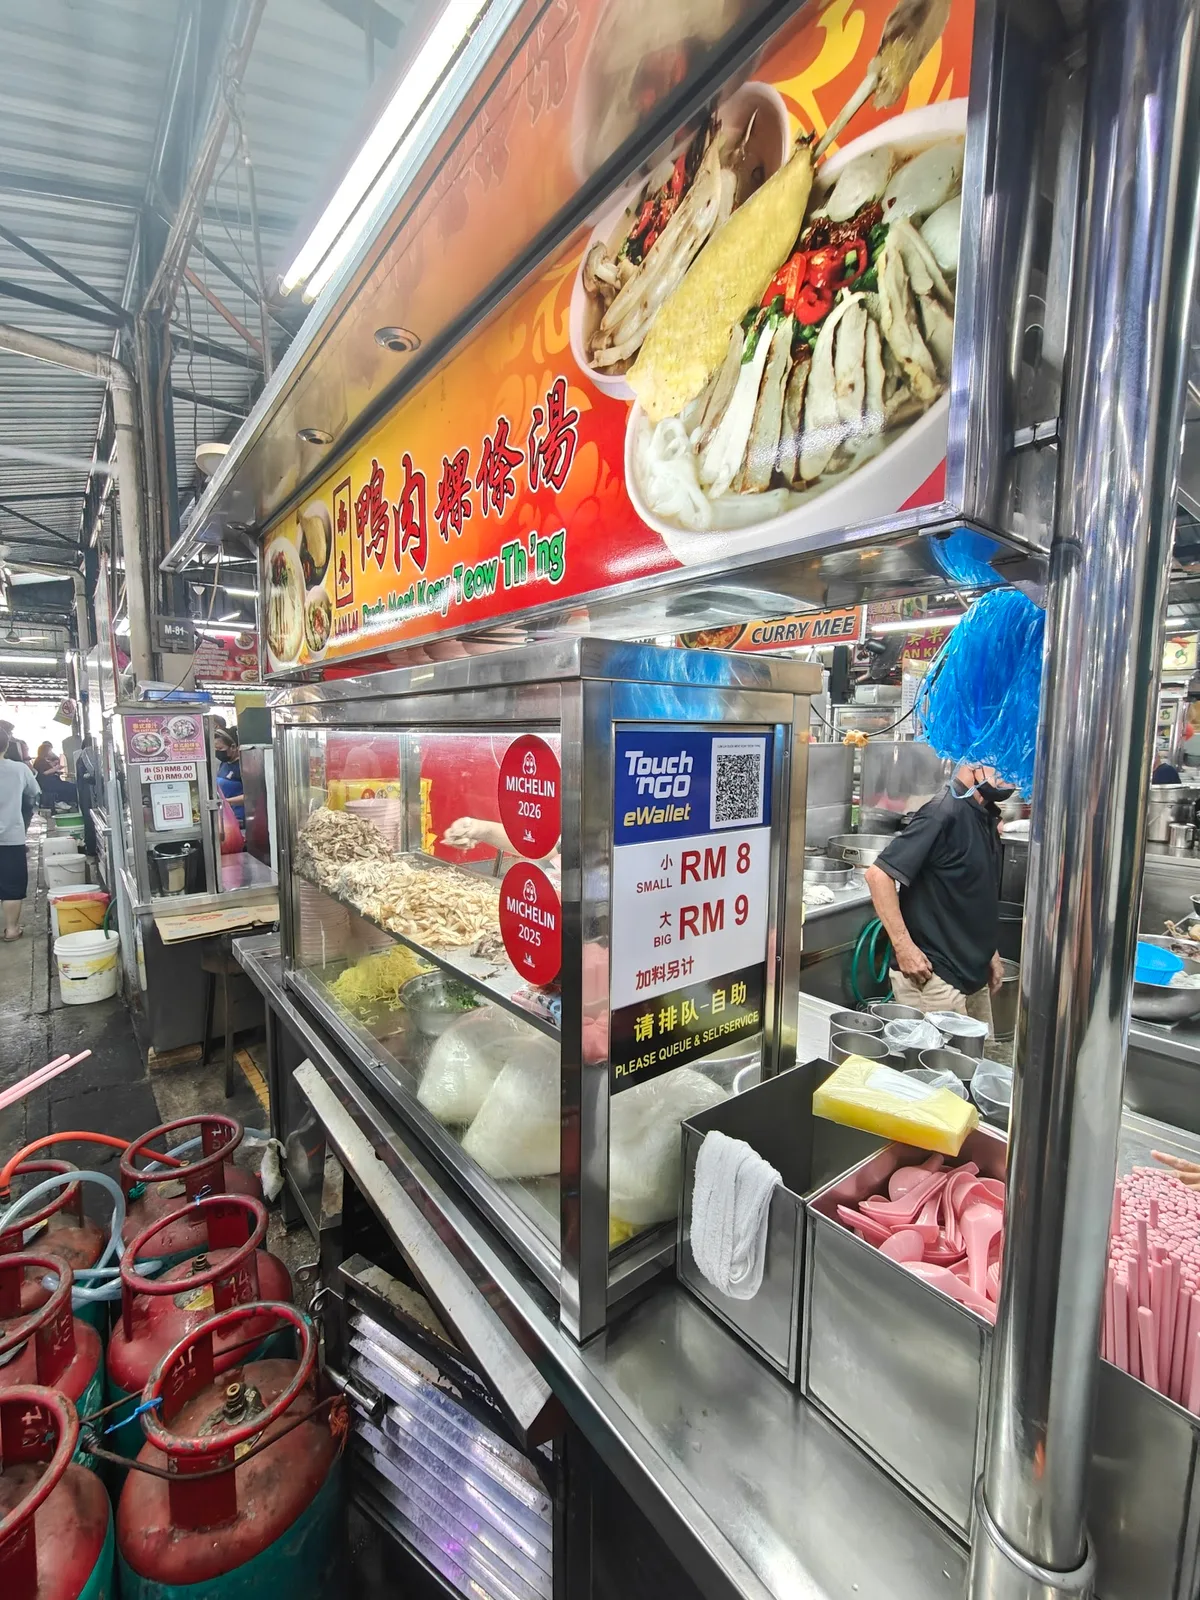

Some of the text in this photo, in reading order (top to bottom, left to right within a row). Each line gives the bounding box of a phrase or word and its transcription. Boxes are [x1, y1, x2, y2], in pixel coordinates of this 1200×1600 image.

[453, 557, 498, 603] Teow
[164, 624, 185, 636] M-81
[751, 615, 856, 645] CURRY MEE
[164, 764, 193, 773] RM8.00
[624, 750, 694, 776] Touch
[153, 774, 165, 782] (B)
[165, 772, 193, 780] RM9.00
[506, 775, 556, 798] MICHELIN
[517, 800, 542, 819] 2026
[623, 802, 691, 827] eWallet
[660, 854, 673, 870] 小
[680, 842, 751, 885] RM 8
[636, 877, 673, 894] SMALL
[506, 896, 556, 931] MICHELIN
[659, 911, 672, 928] 大
[679, 894, 749, 941] RM 9
[517, 923, 542, 947] 2025
[653, 933, 672, 948] BIG
[635, 955, 695, 991] 加料另计
[615, 1010, 760, 1079] PLEASE QUEUE & SELFSERVICE
